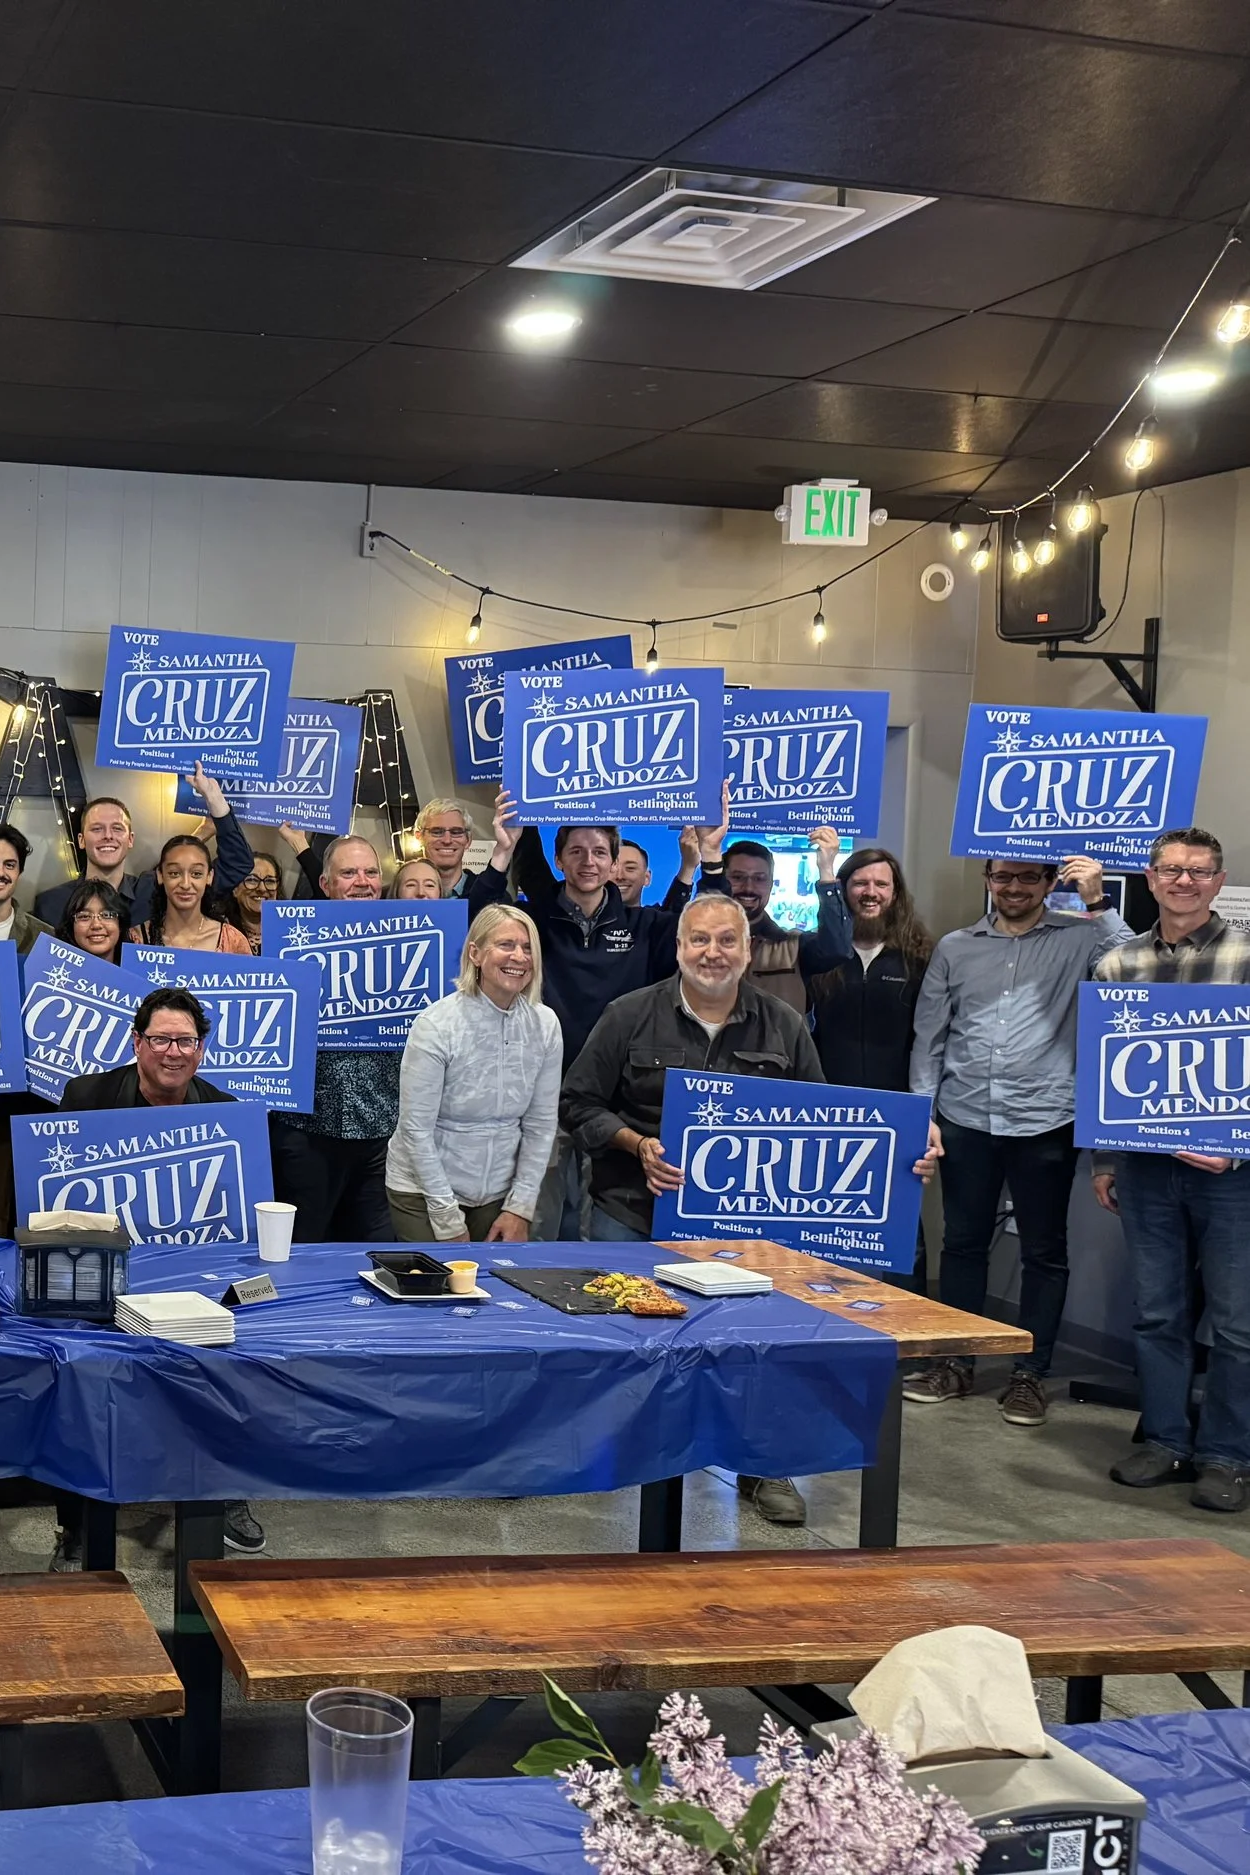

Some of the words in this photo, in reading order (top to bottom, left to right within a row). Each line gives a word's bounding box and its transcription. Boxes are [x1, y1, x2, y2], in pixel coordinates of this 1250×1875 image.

[804, 488, 860, 538] EXIT
[124, 632, 159, 645] VOTE
[158, 654, 263, 667] SAMANTHA
[458, 657, 493, 669] VOTE
[520, 676, 561, 687] VOTE
[126, 678, 258, 726] CRUZ
[565, 684, 689, 710] SAMANTHA
[734, 705, 853, 726] SAMANTHA
[986, 711, 1030, 724] VOTE
[143, 726, 253, 740] MENDOZA
[1029, 730, 1165, 747] SAMANTHA
[532, 710, 685, 776] CRUZ
[201, 753, 258, 767] Bellingham
[225, 749, 244, 757] Port
[556, 765, 688, 792] MENDOZA
[989, 756, 1159, 812] CRUZ
[220, 779, 325, 793] MENDOZA
[657, 791, 680, 800] Port
[683, 791, 695, 799] of
[629, 799, 698, 811] Bellingham
[815, 805, 837, 813] Port
[788, 811, 854, 823] Bellingham
[1010, 811, 1152, 828] MENDOZA
[1006, 837, 1042, 846] Position
[276, 907, 315, 917] VOTE
[318, 915, 433, 939] SAMANTHA
[50, 943, 84, 967] VOTE
[137, 949, 174, 963] VOTE
[175, 974, 288, 986] SAMANTHA
[1098, 989, 1148, 1001] VOTE
[1151, 1006, 1250, 1027] SAMAN
[25, 996, 136, 1064] CRU
[1111, 1036, 1250, 1098] CRU
[254, 1075, 275, 1085] Port
[684, 1078, 732, 1094] VOTE
[228, 1080, 291, 1095] Bellingham
[734, 1107, 884, 1122] SAMANTHA
[30, 1120, 79, 1135] VOTE
[1138, 1125, 1181, 1135] Position
[85, 1122, 227, 1161] SAMANTHA
[691, 1135, 878, 1195] CRUZ
[717, 1196, 874, 1215] MENDOZA
[713, 1222, 753, 1234] Position
[755, 1227, 761, 1235] 4
[835, 1226, 862, 1238] Port
[867, 1232, 881, 1240] of
[800, 1231, 883, 1251] Bellingham
[240, 1284, 274, 1300] Reserved
[1036, 1822, 1052, 1832] OUR
[1053, 1818, 1092, 1829] CALENDAR
